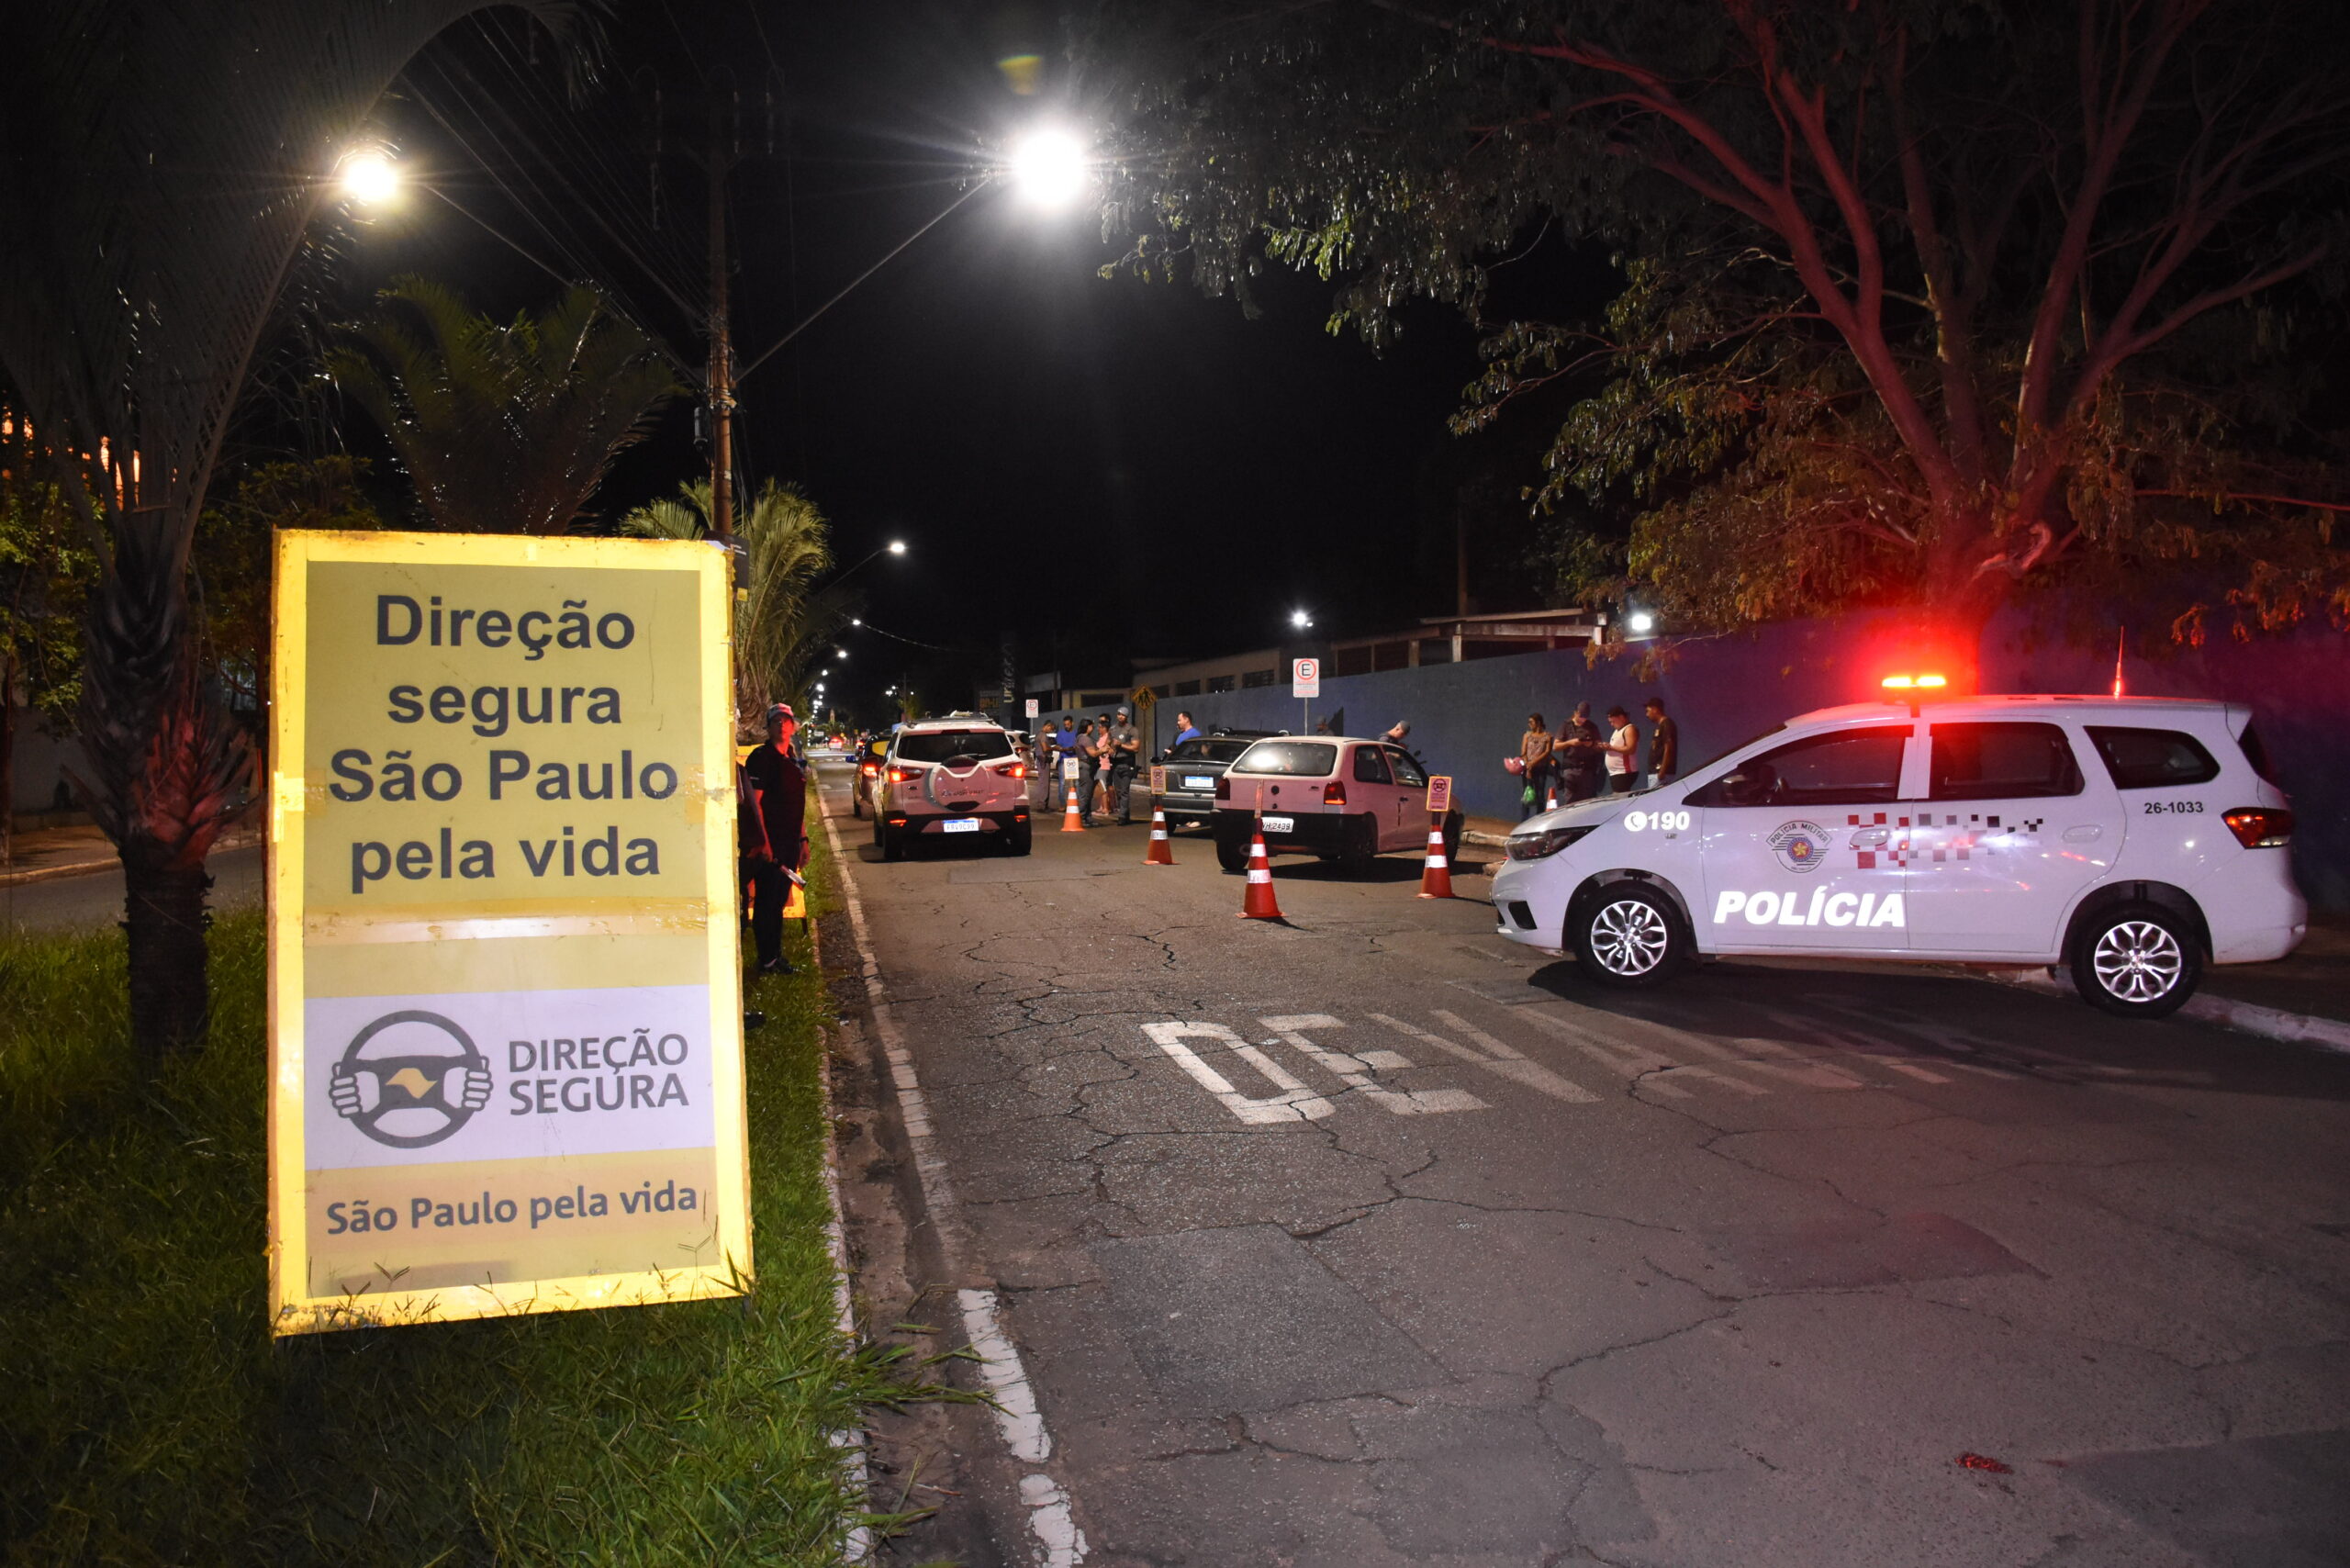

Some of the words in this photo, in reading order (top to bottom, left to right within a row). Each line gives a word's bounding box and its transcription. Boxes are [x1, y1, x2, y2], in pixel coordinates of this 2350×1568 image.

[376, 594, 635, 661] Direção
[1302, 663, 1311, 676] E
[386, 685, 621, 737] segura
[329, 748, 463, 802] São
[489, 749, 678, 801] Paulo
[1649, 811, 1691, 831] 190
[2143, 801, 2204, 814] 26-1033
[1801, 823, 1829, 844] MILITAR
[352, 827, 496, 895] pela
[518, 825, 661, 878] vida
[1713, 886, 1906, 928] POLÍCIA
[509, 1027, 688, 1075] DIREÇÃO
[509, 1073, 689, 1115] SEGURA
[326, 1200, 398, 1235] São
[410, 1192, 518, 1229] Paulo
[530, 1184, 609, 1229] pela
[619, 1179, 698, 1215] vida
